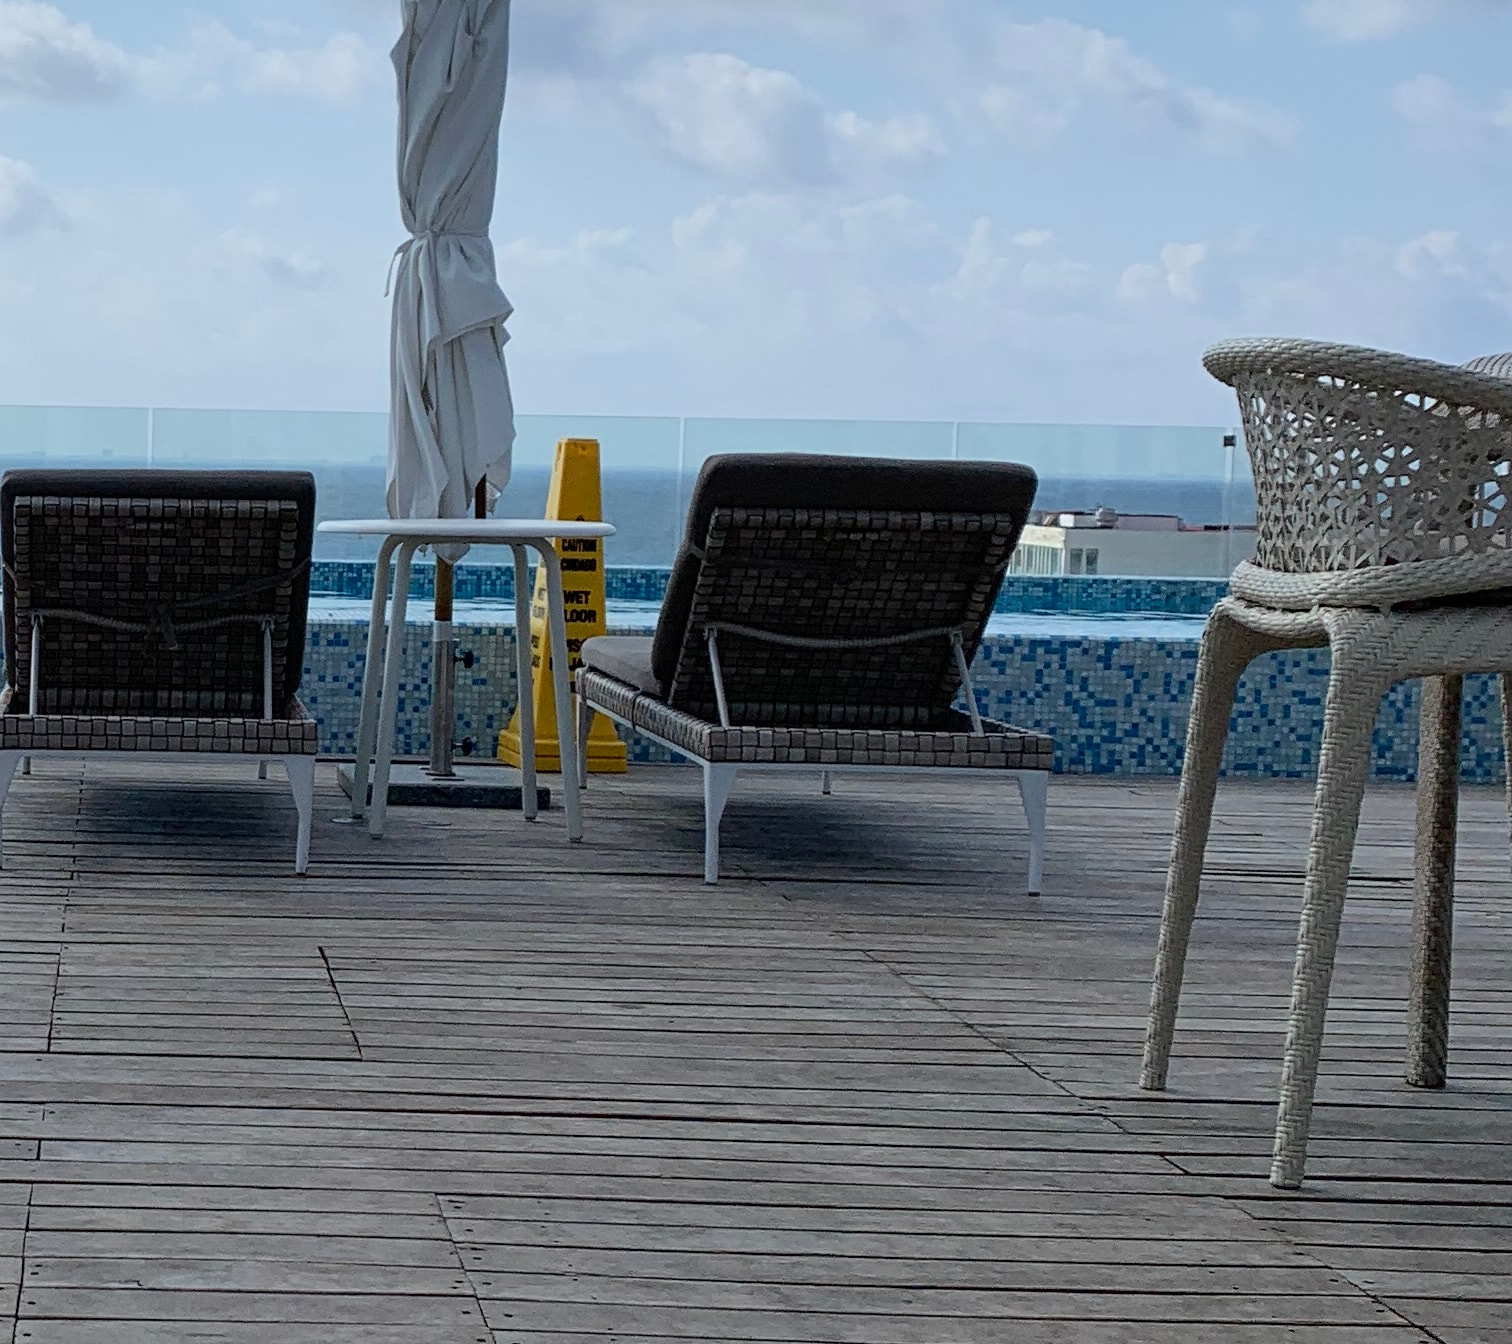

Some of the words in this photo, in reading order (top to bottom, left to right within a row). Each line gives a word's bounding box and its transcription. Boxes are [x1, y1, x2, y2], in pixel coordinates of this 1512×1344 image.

[562, 539, 597, 552] CAUTION
[563, 590, 592, 605] WET
[564, 609, 597, 624] LOOR
